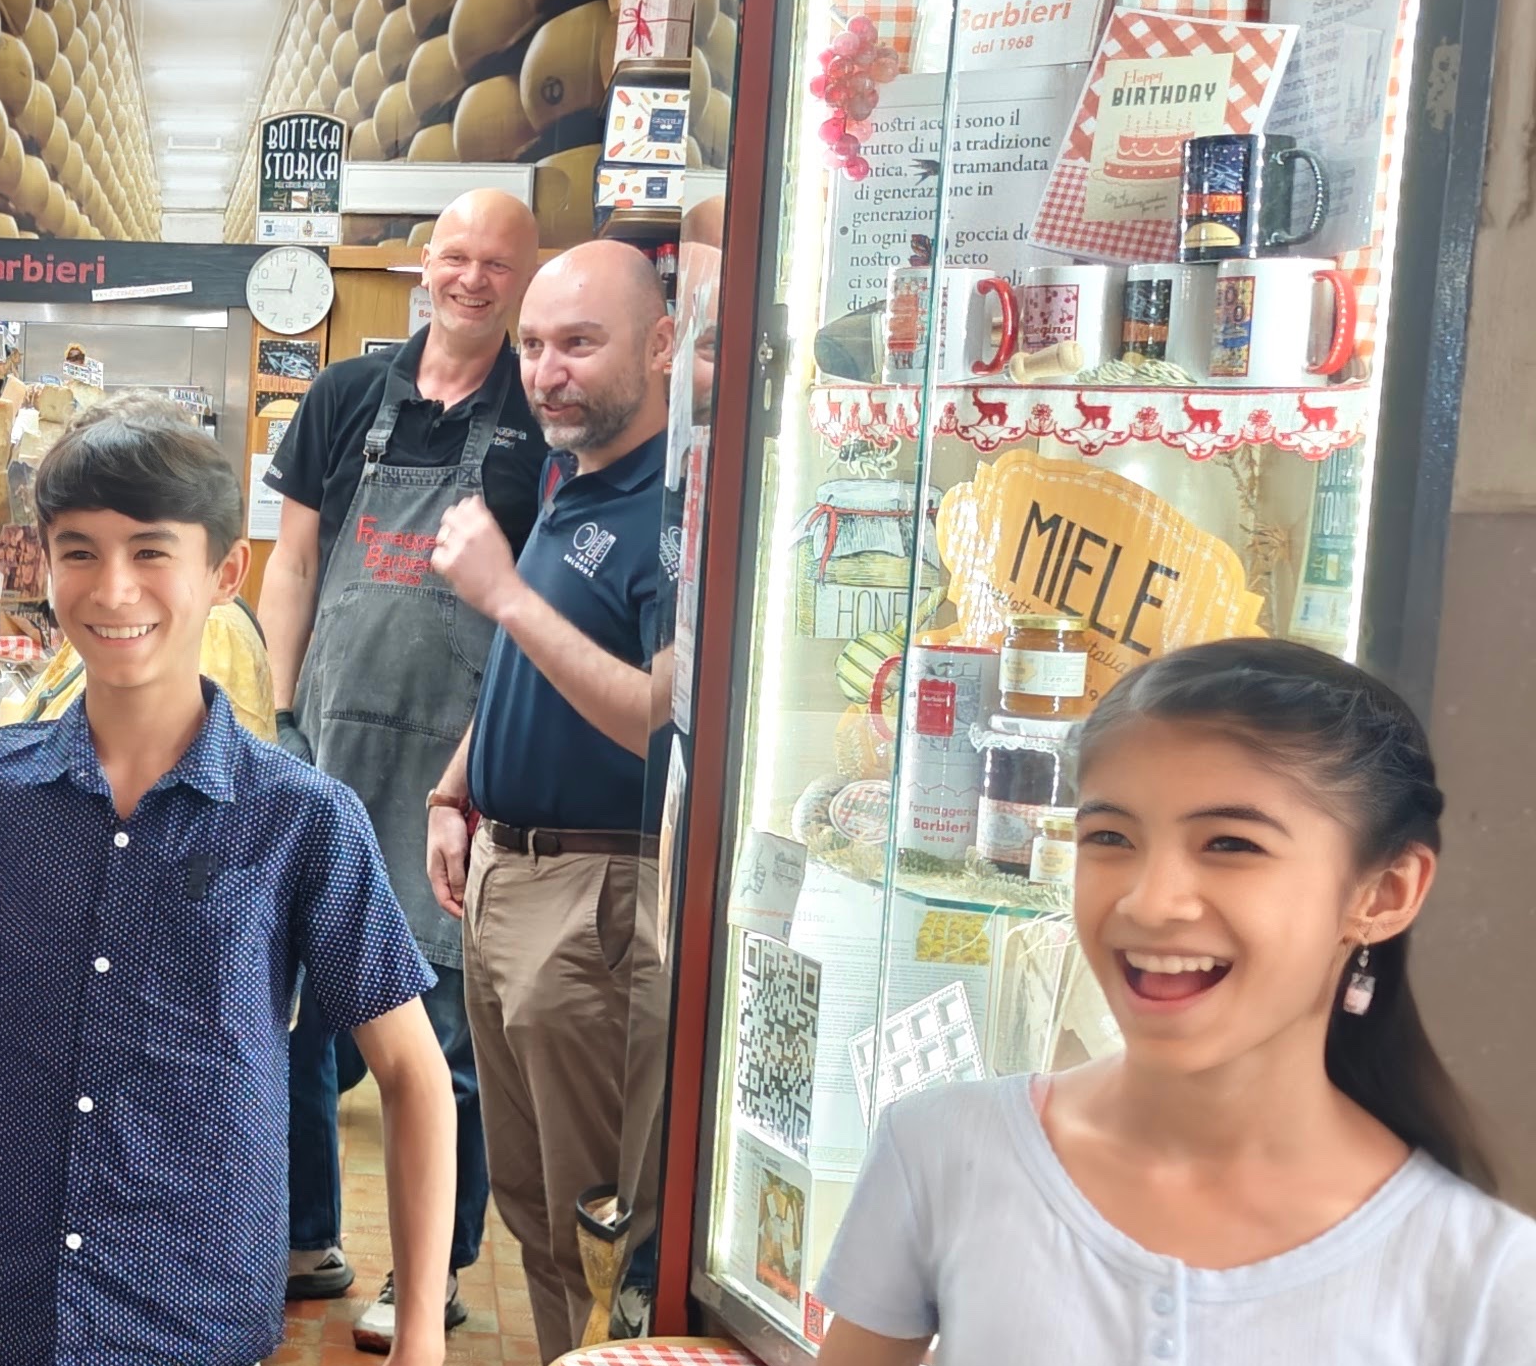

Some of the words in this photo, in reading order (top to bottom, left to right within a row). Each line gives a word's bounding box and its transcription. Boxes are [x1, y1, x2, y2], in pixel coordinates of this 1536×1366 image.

[972, 39, 995, 55] dal
[999, 35, 1034, 51] 1968
[1111, 82, 1217, 108] BIRTHDAY
[871, 117, 916, 133] nostri
[965, 115, 1005, 129] sono
[1010, 108, 1020, 127] il
[266, 118, 341, 151] BOTTEGA
[908, 137, 925, 154] di
[966, 134, 1052, 152] tradizione
[264, 152, 340, 181] STORICA
[868, 161, 908, 178] ntica,
[953, 155, 1050, 174] tramandata
[854, 184, 871, 201] di
[874, 185, 973, 206] generazone
[977, 183, 994, 198] in
[851, 229, 868, 246] In
[871, 230, 907, 251] ogni
[955, 226, 1008, 248] goccia
[850, 250, 901, 267] nostro
[945, 249, 989, 266] aceto
[356, 515, 436, 551] Formagge
[563, 553, 595, 579] BOLOGNA
[575, 551, 600, 571] TASTE
[1009, 500, 1180, 657] MIELE
[839, 588, 913, 634] HONE
[913, 817, 972, 834] Barbieri
